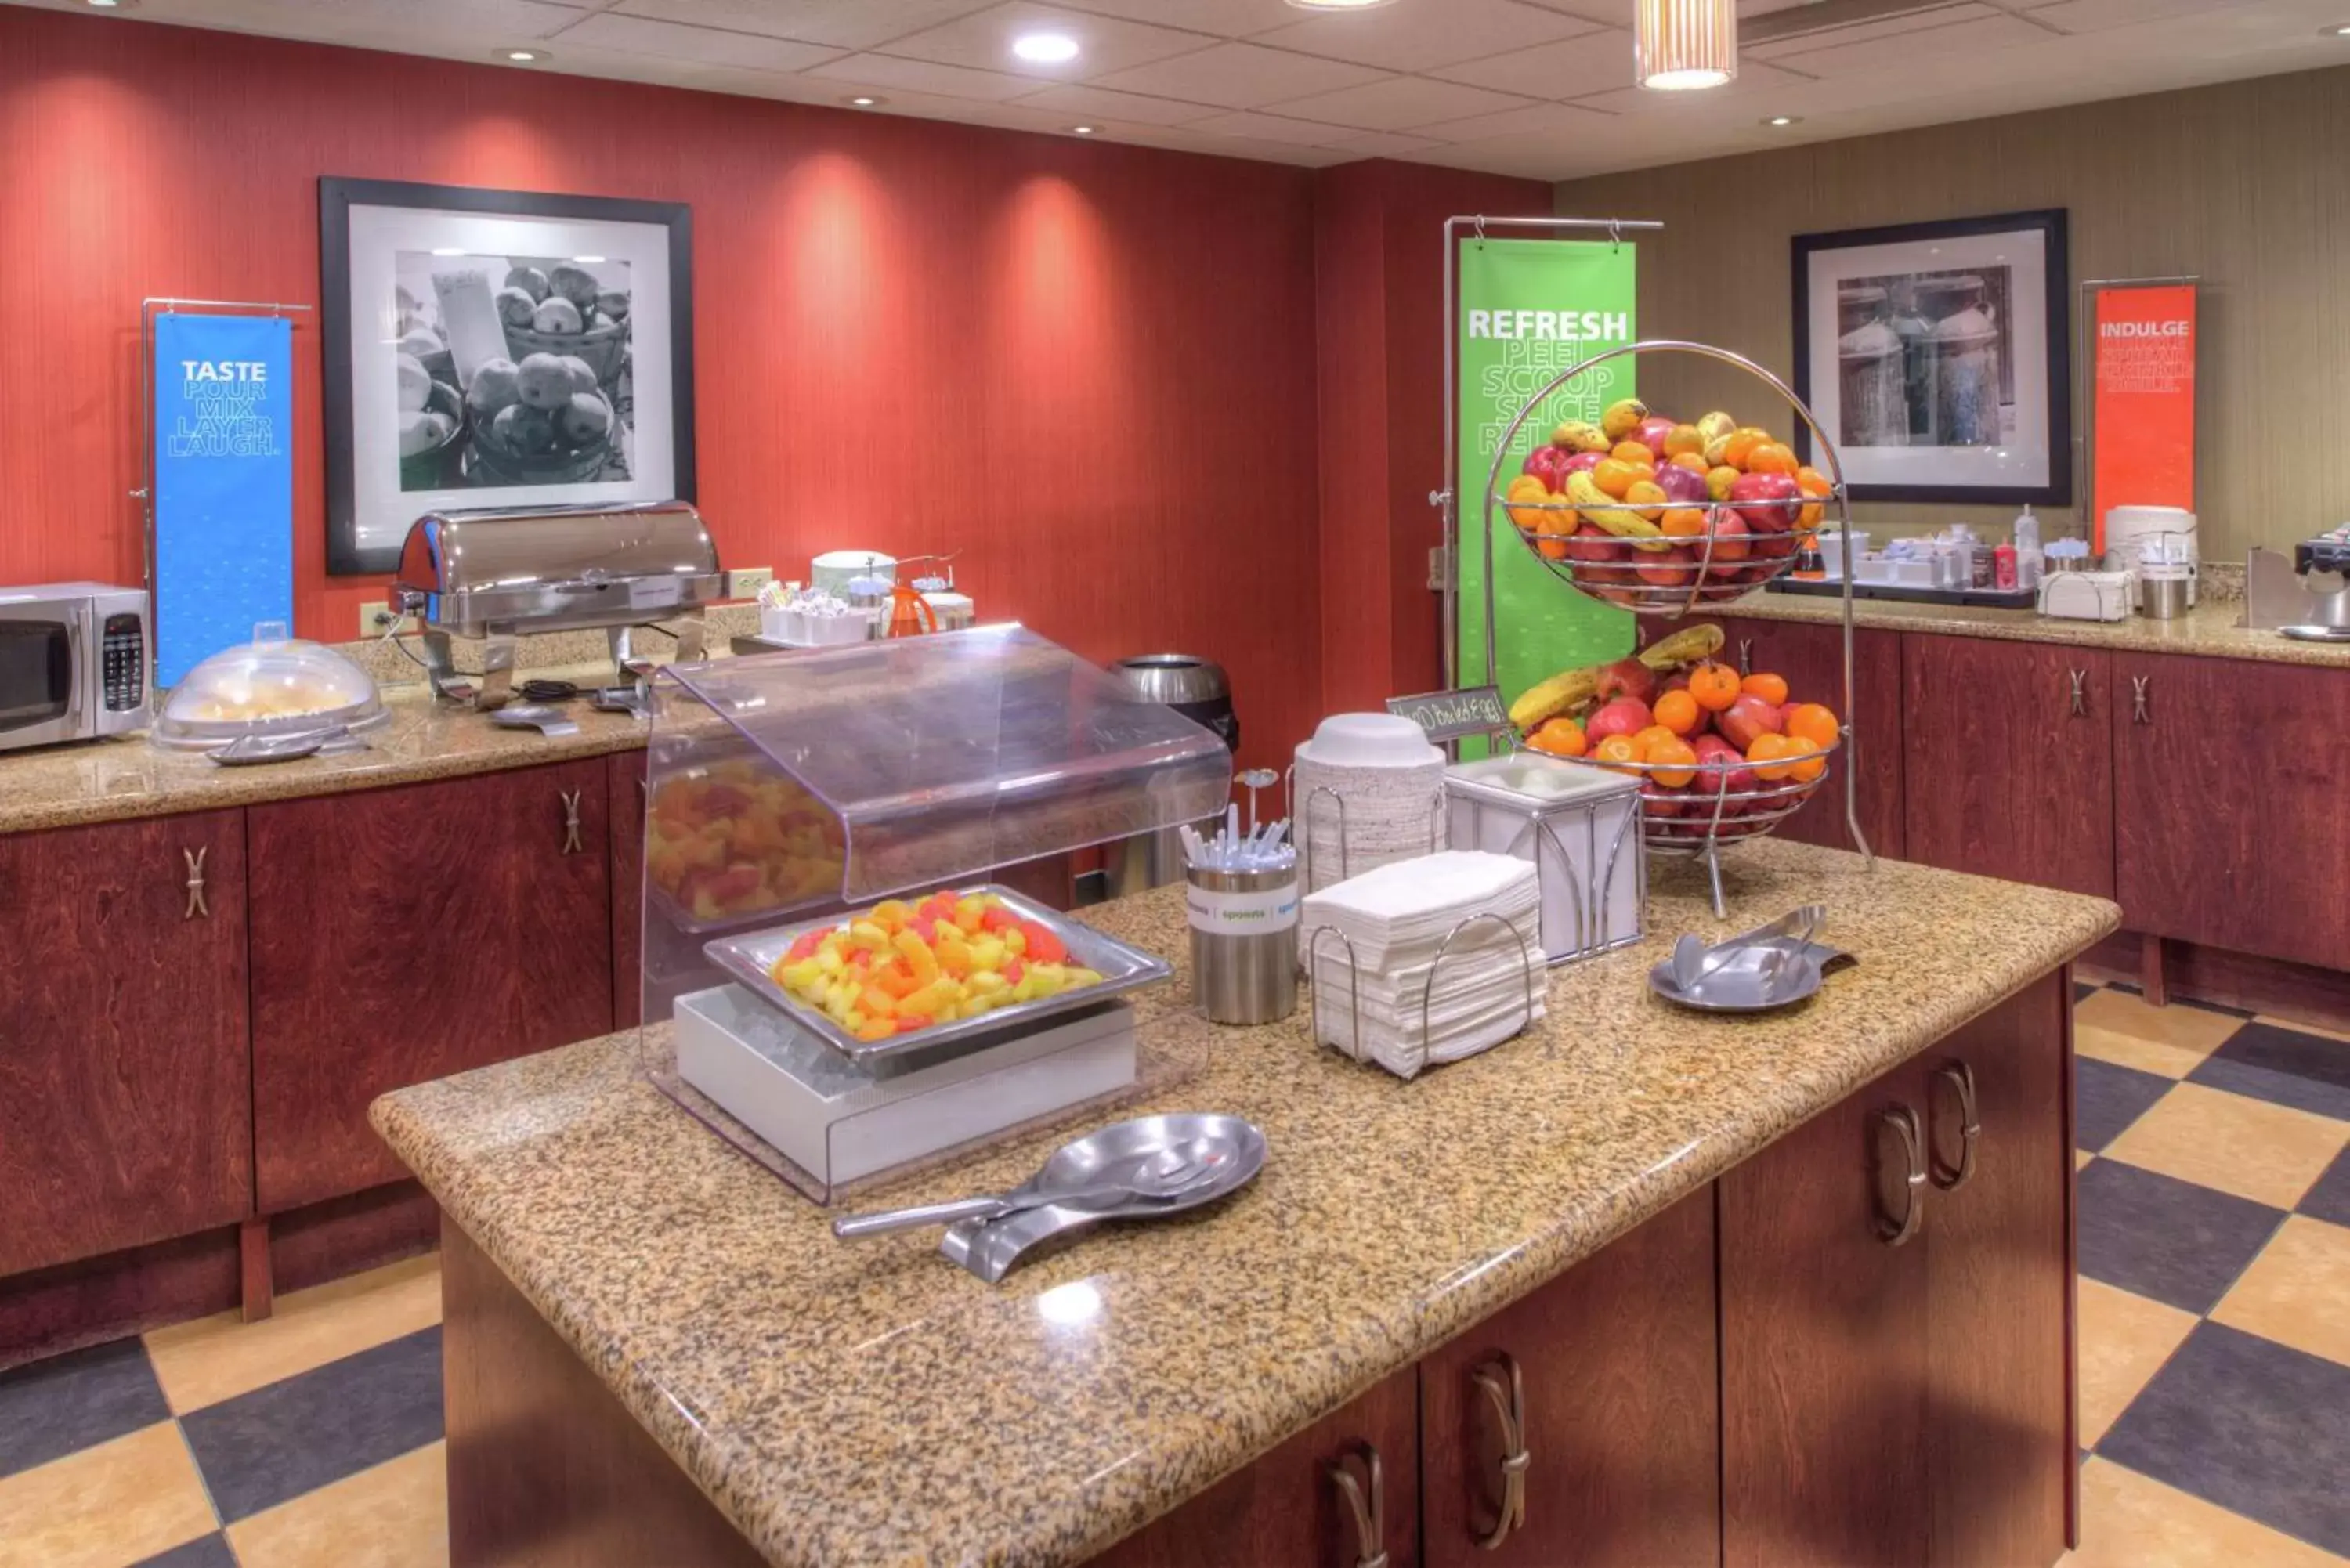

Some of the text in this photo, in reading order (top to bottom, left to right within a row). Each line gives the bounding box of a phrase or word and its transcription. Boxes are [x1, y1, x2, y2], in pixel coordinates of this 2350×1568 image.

[1468, 309, 1627, 341] REFRESH
[2101, 320, 2190, 338] INDULGE
[181, 360, 268, 382] TASTE
[1482, 365, 1614, 398] SCOOP
[184, 380, 267, 400] POUR
[195, 397, 255, 418] MIX
[1495, 394, 1602, 426] SLICE
[177, 416, 273, 439] LAYER
